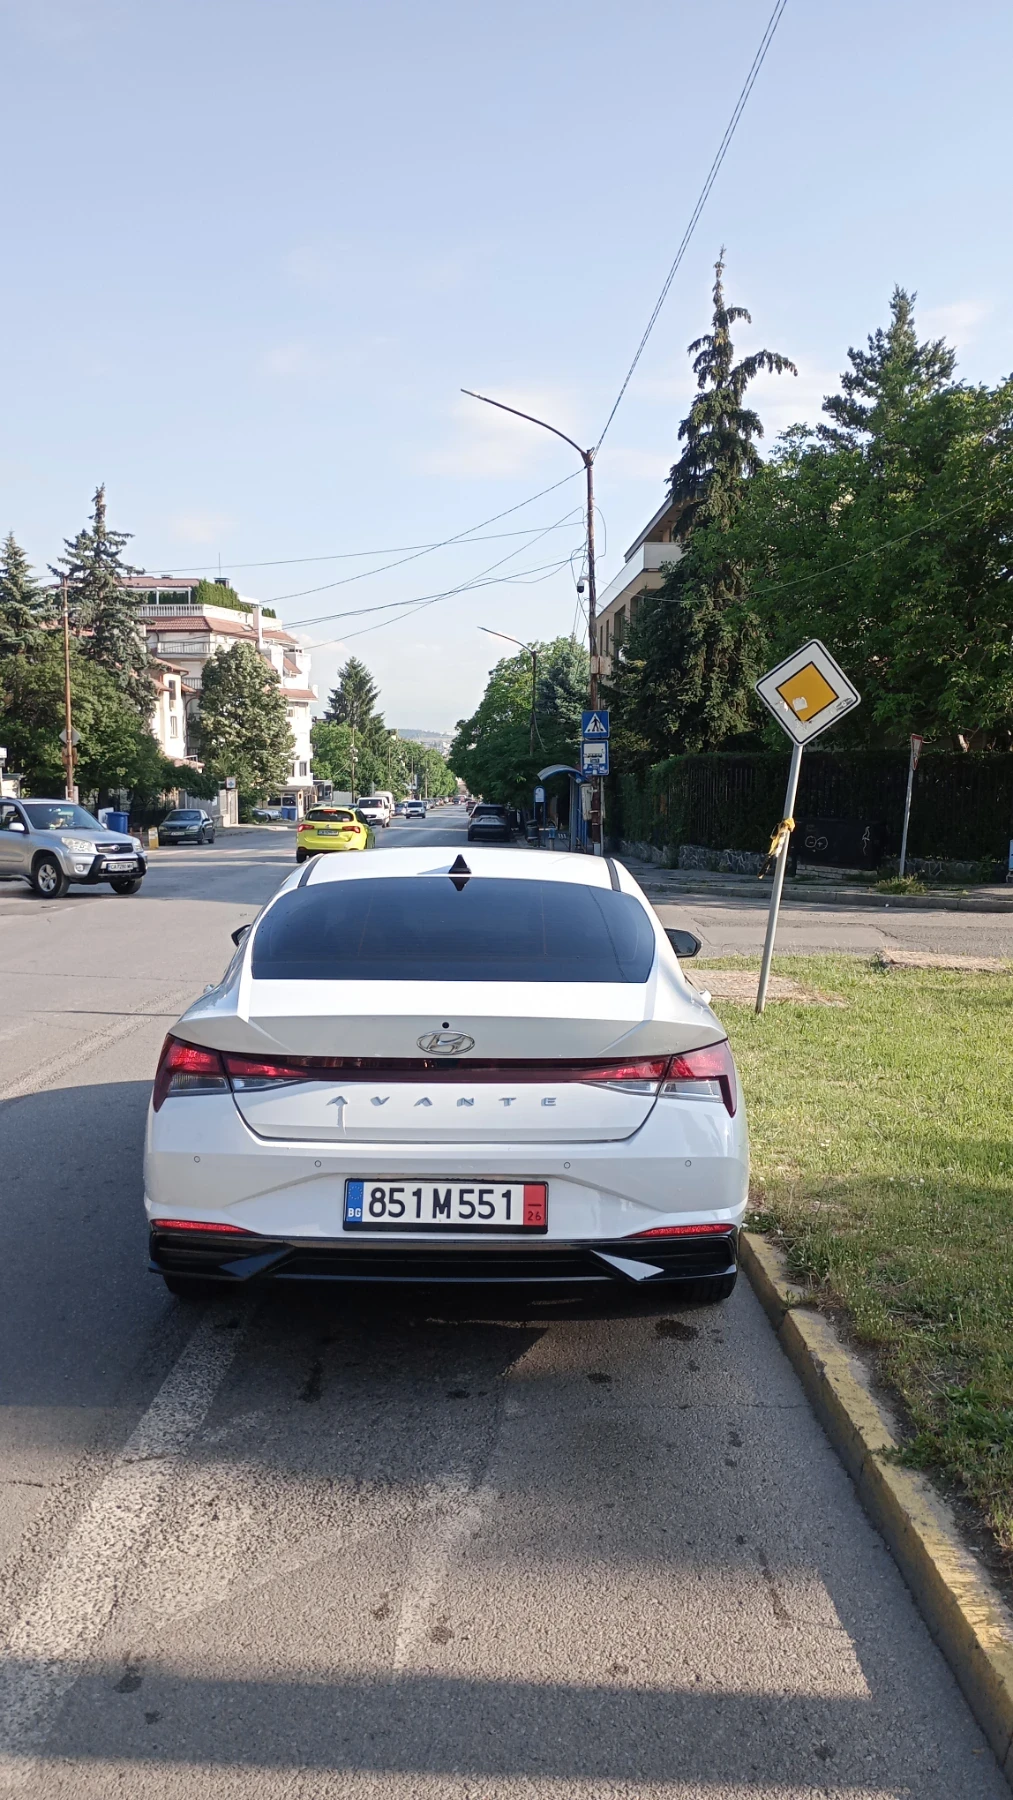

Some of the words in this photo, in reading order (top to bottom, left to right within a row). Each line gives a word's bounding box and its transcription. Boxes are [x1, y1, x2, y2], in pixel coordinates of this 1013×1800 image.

[326, 1095, 558, 1108] AVANTE
[348, 1208, 362, 1218] BG
[527, 1211, 542, 1221] 26
